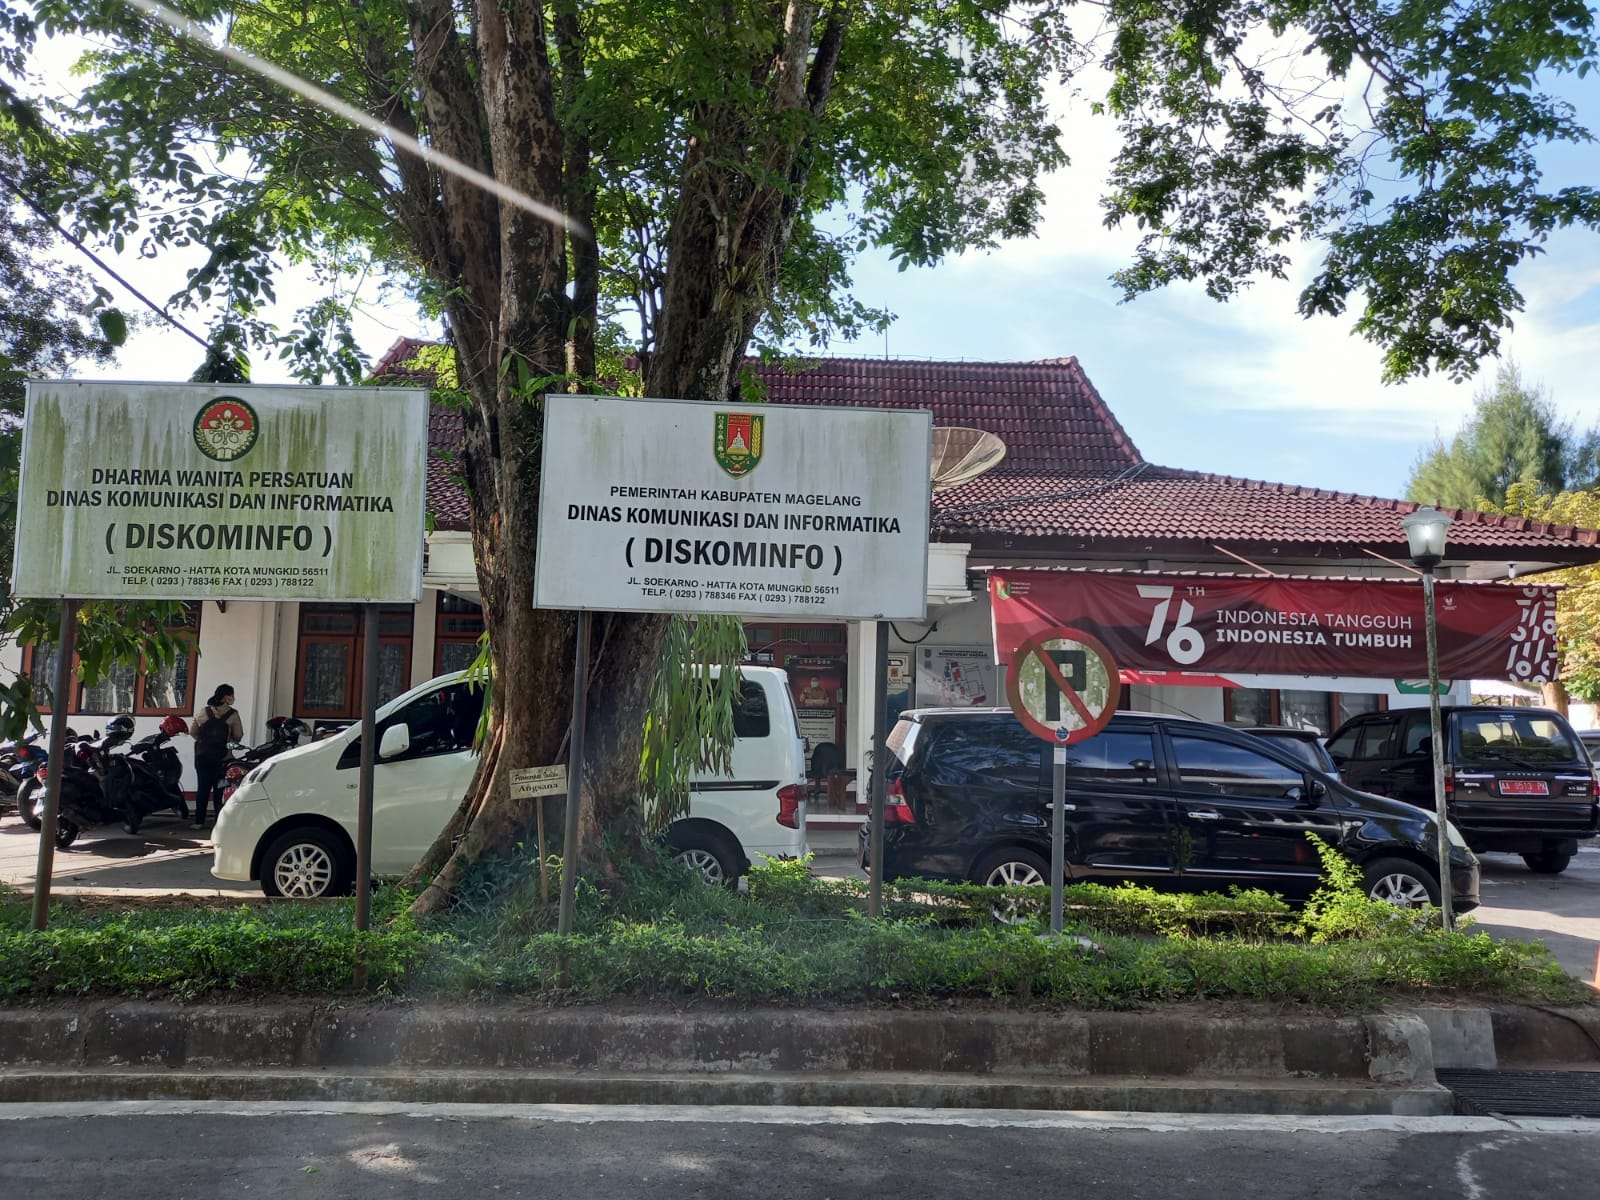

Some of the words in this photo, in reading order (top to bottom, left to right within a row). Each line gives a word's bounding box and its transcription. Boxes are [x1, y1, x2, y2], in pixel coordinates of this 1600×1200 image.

[92, 468, 172, 486] DHARMA
[176, 470, 244, 488] WANITA
[249, 471, 353, 489] PERSATUAN
[46, 490, 102, 507] DINAS
[107, 490, 224, 508] KOMUNIKASI
[229, 493, 266, 510] DAN
[270, 494, 394, 513] INFORMATIKA
[610, 486, 697, 500] PEMERINTAH
[700, 489, 781, 504] KABUPATEN
[785, 493, 862, 507] MAGELANG
[567, 504, 622, 522] DINAS
[626, 507, 738, 528] KOMUNIKASI
[743, 512, 779, 530] DAN
[784, 514, 901, 534] INFORMATIKA
[125, 523, 313, 551] DISKOMINFO
[644, 537, 824, 570] DISKOMINFO
[106, 566, 121, 575] JL.
[123, 566, 181, 575] SOEKARNO
[189, 566, 221, 576] HATTA
[223, 567, 251, 576] KOTA
[252, 567, 300, 577] MUNGKID
[302, 568, 329, 577] 56511
[121, 576, 148, 586] TELP.
[156, 576, 179, 586] 0293
[187, 577, 220, 586] 788346
[222, 577, 242, 586] FAX
[250, 577, 273, 587] 0293
[281, 577, 314, 588] 788122
[627, 577, 641, 586] JL.
[643, 577, 699, 589] SOEKARNO
[706, 580, 737, 590] HATTA
[739, 582, 765, 591] KOTA
[767, 583, 812, 594] MUNGKID
[814, 585, 840, 595] 56511
[641, 587, 667, 597] TELP.
[675, 589, 697, 599] 0293
[704, 590, 736, 601] 788346
[738, 592, 757, 601] FAX
[765, 593, 787, 603] 0293
[794, 594, 825, 605] 788122
[1136, 585, 1205, 665] 76
[1186, 586, 1206, 597] TH
[1216, 609, 1320, 627] INDONESIA
[1324, 613, 1412, 630] TANGGUH
[1216, 628, 1327, 646] INDONESIA
[1332, 632, 1412, 649] TUMBUH
[1044, 649, 1087, 722] P
[518, 783, 559, 793] Angsana
